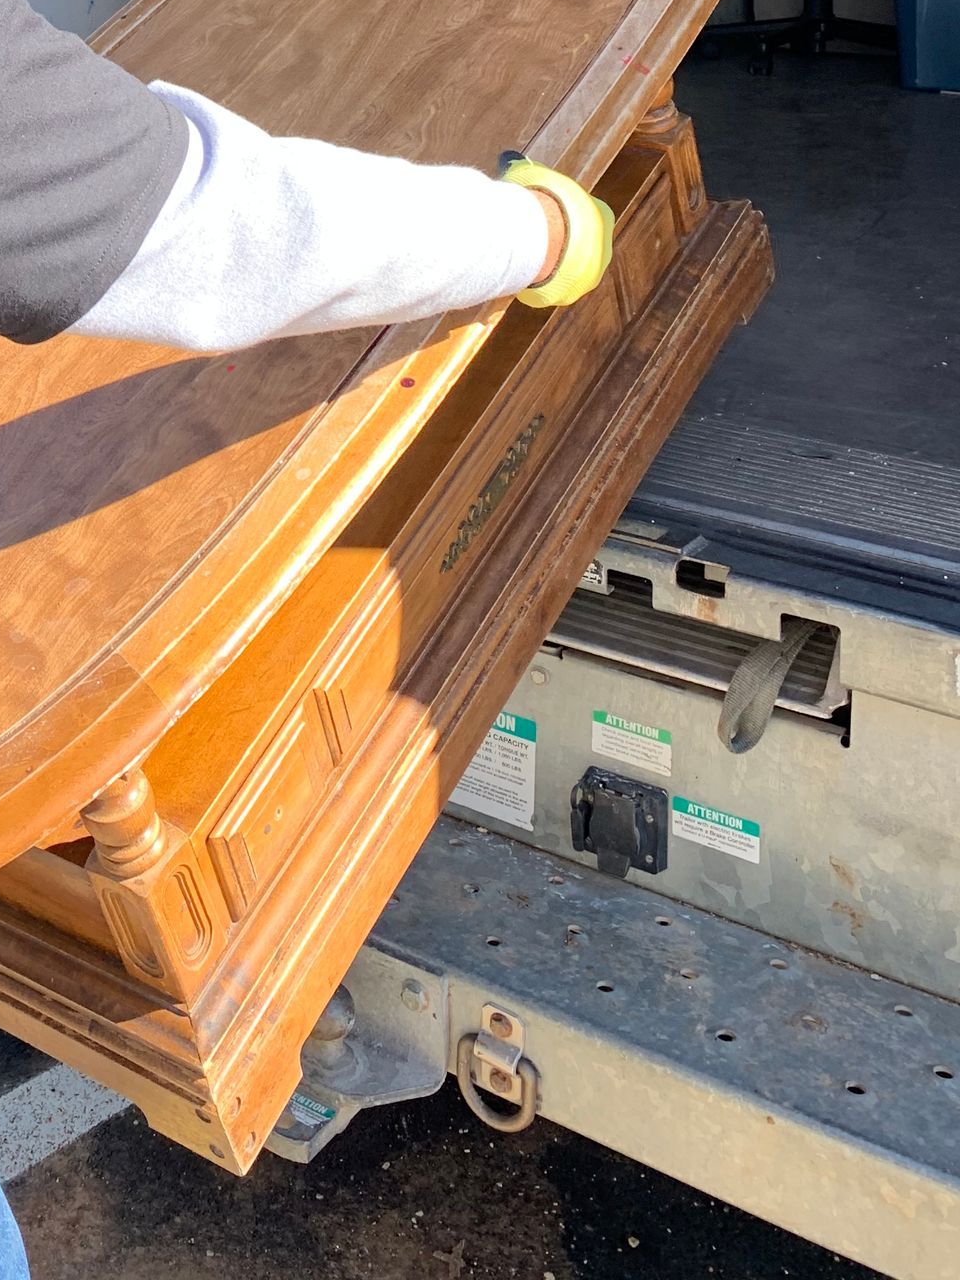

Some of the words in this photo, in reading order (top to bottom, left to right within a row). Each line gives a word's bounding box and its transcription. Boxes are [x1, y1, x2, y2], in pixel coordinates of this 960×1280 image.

[605, 714, 659, 739] ATTENTION
[493, 732, 529, 750] CAPACITY
[687, 803, 743, 830] ATTENTION
[292, 1094, 328, 1115] ENTION
